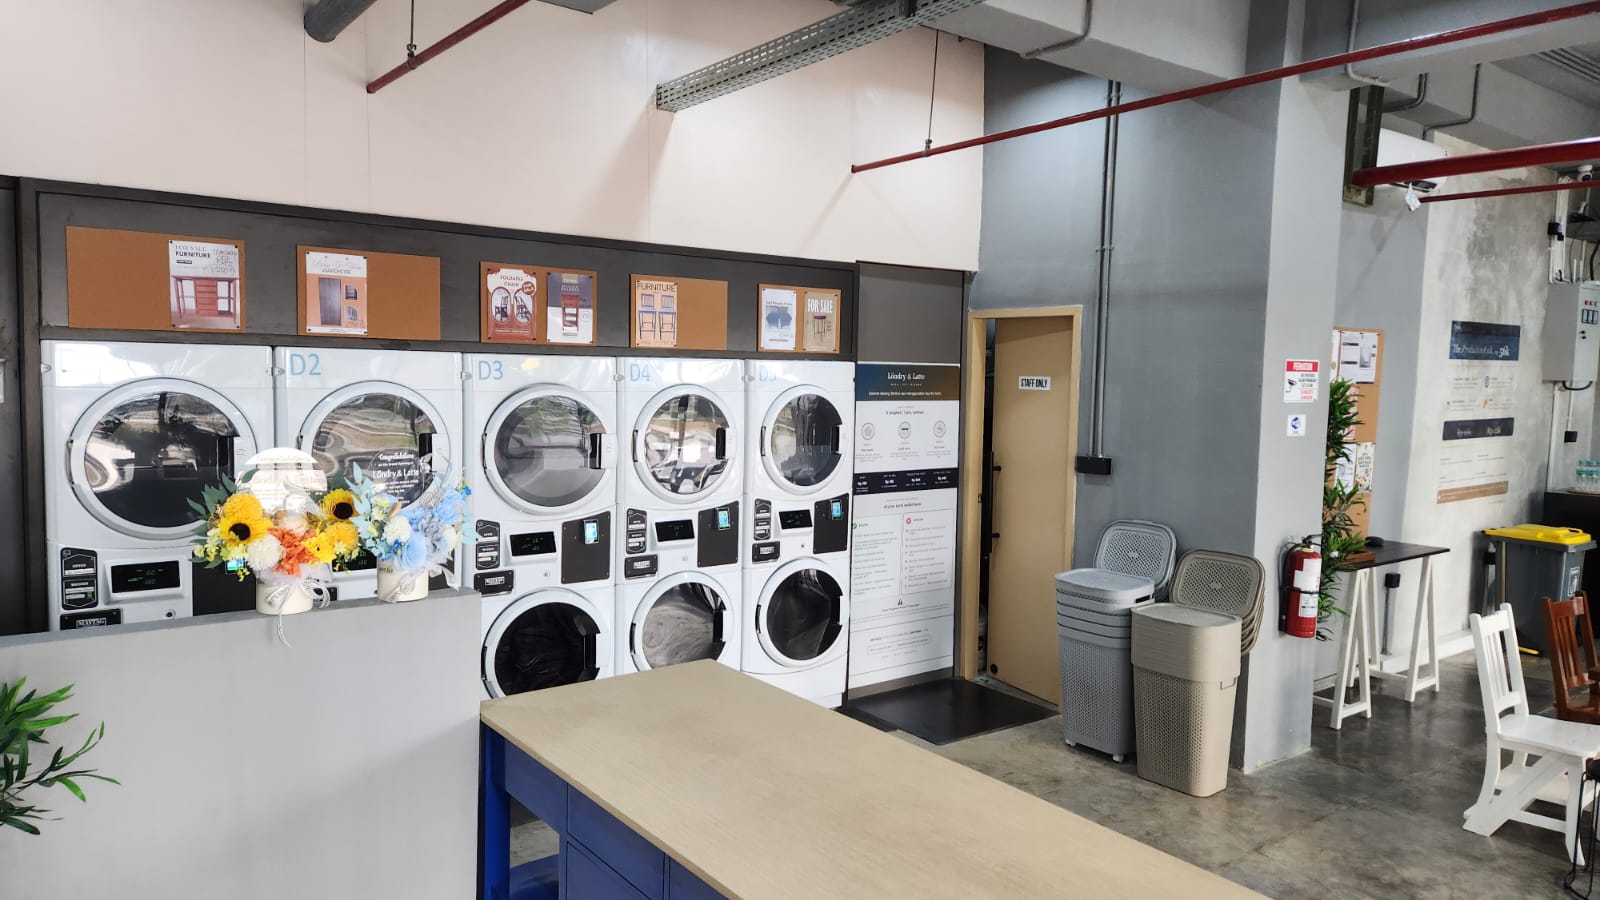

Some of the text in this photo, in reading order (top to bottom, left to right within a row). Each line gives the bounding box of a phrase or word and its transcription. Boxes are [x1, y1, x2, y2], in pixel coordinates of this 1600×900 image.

[175, 251, 210, 259] FURNITURE
[637, 282, 676, 292] FURNITURE
[807, 298, 819, 313] FOR
[820, 299, 833, 313] SALE
[289, 353, 321, 376] D2
[478, 360, 503, 380] D3
[630, 363, 651, 382] D4
[1021, 378, 1047, 388] STAFF ONLY
[397, 469, 403, 477] &
